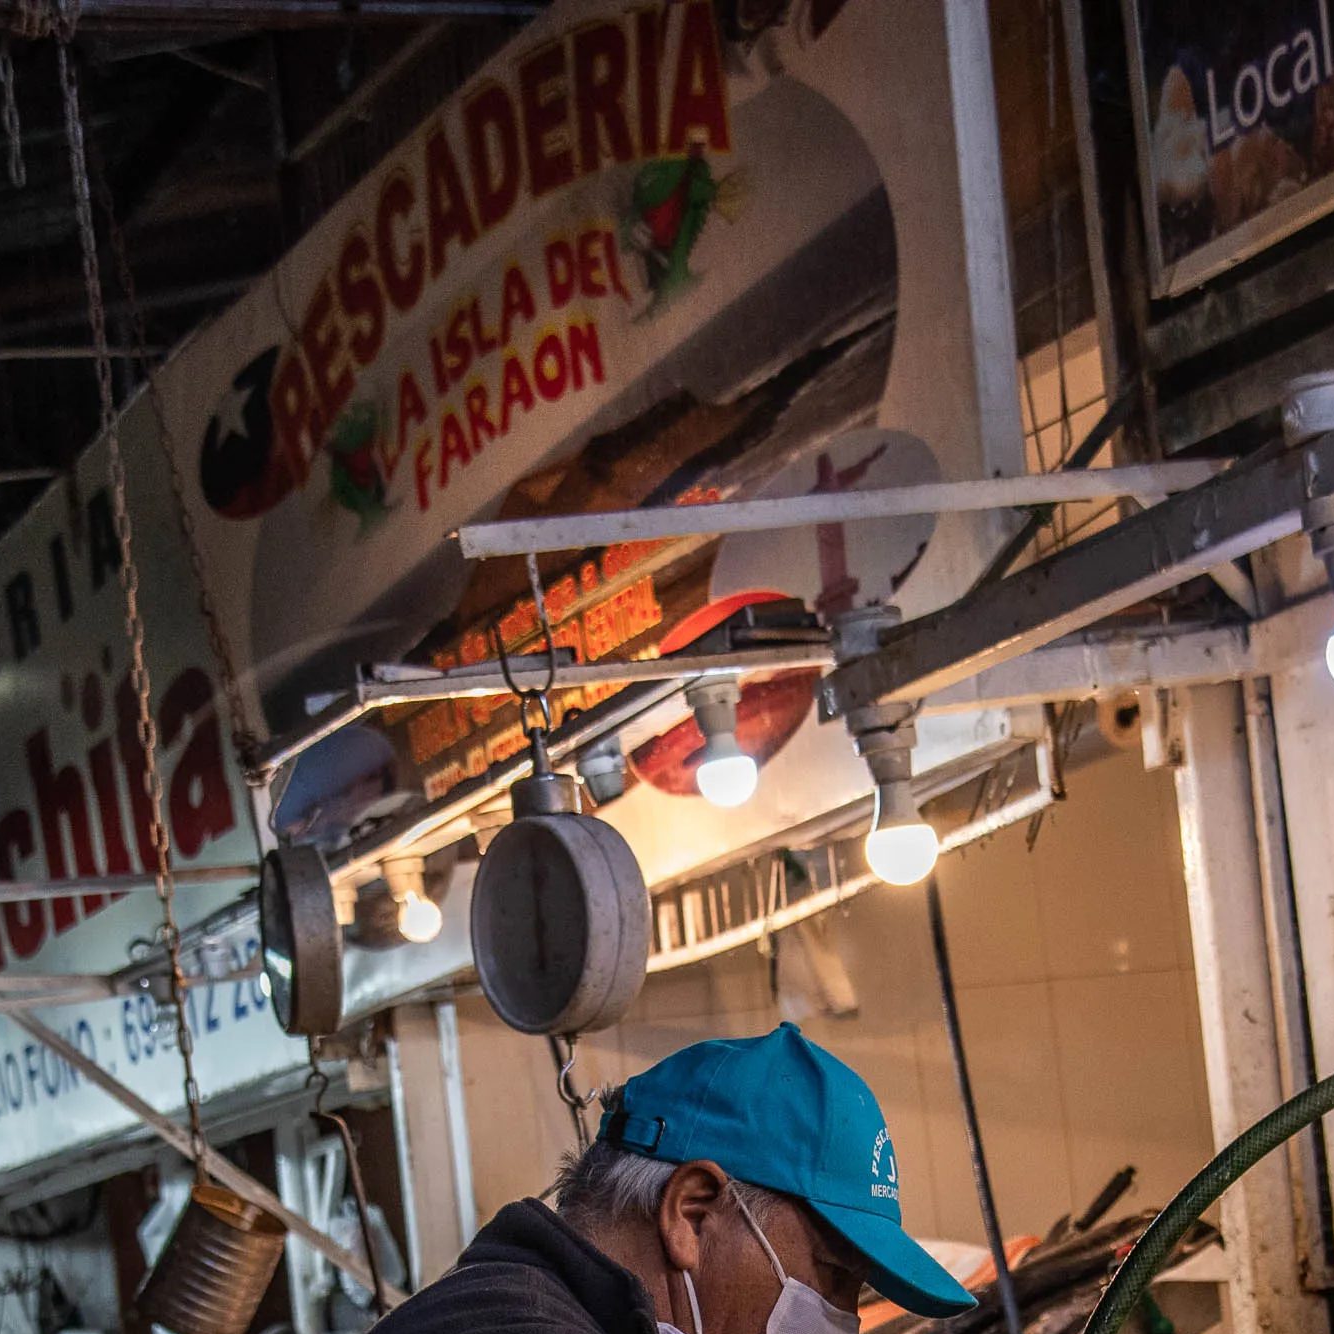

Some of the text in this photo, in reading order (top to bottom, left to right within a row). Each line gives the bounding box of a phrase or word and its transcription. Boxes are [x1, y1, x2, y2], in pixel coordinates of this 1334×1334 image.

[1206, 0, 1334, 147] Local
[271, 0, 732, 488] PESCADERIA
[428, 272, 537, 398] ISLA
[544, 229, 630, 311] DEL
[411, 321, 608, 513] FARAON
